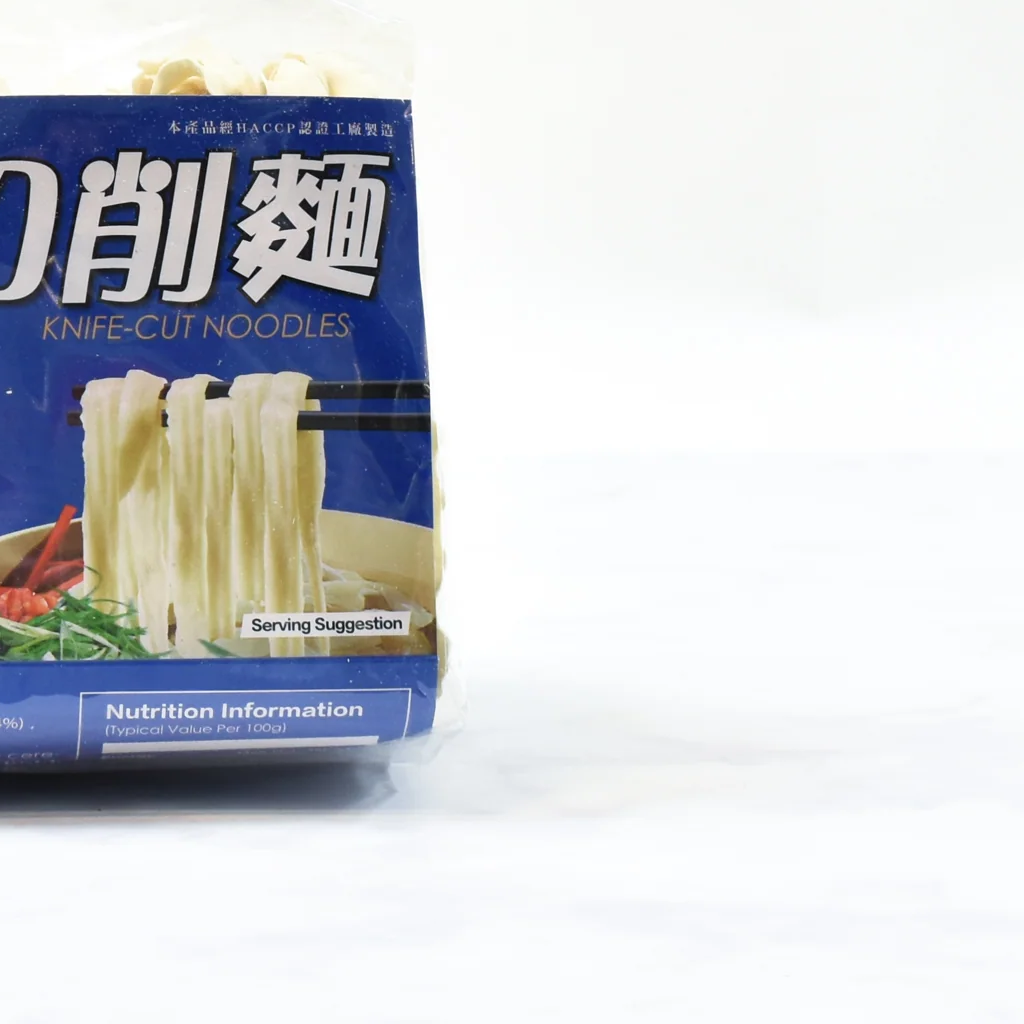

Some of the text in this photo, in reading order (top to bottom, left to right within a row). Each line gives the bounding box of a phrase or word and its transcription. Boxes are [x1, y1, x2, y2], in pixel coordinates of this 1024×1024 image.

[42, 312, 350, 341] KNIFE-CUT NOODLES
[251, 615, 403, 634] Serving Suggestion
[106, 701, 364, 720] Nutrition Information
[105, 722, 287, 736] (Typical Value Per 100g)
